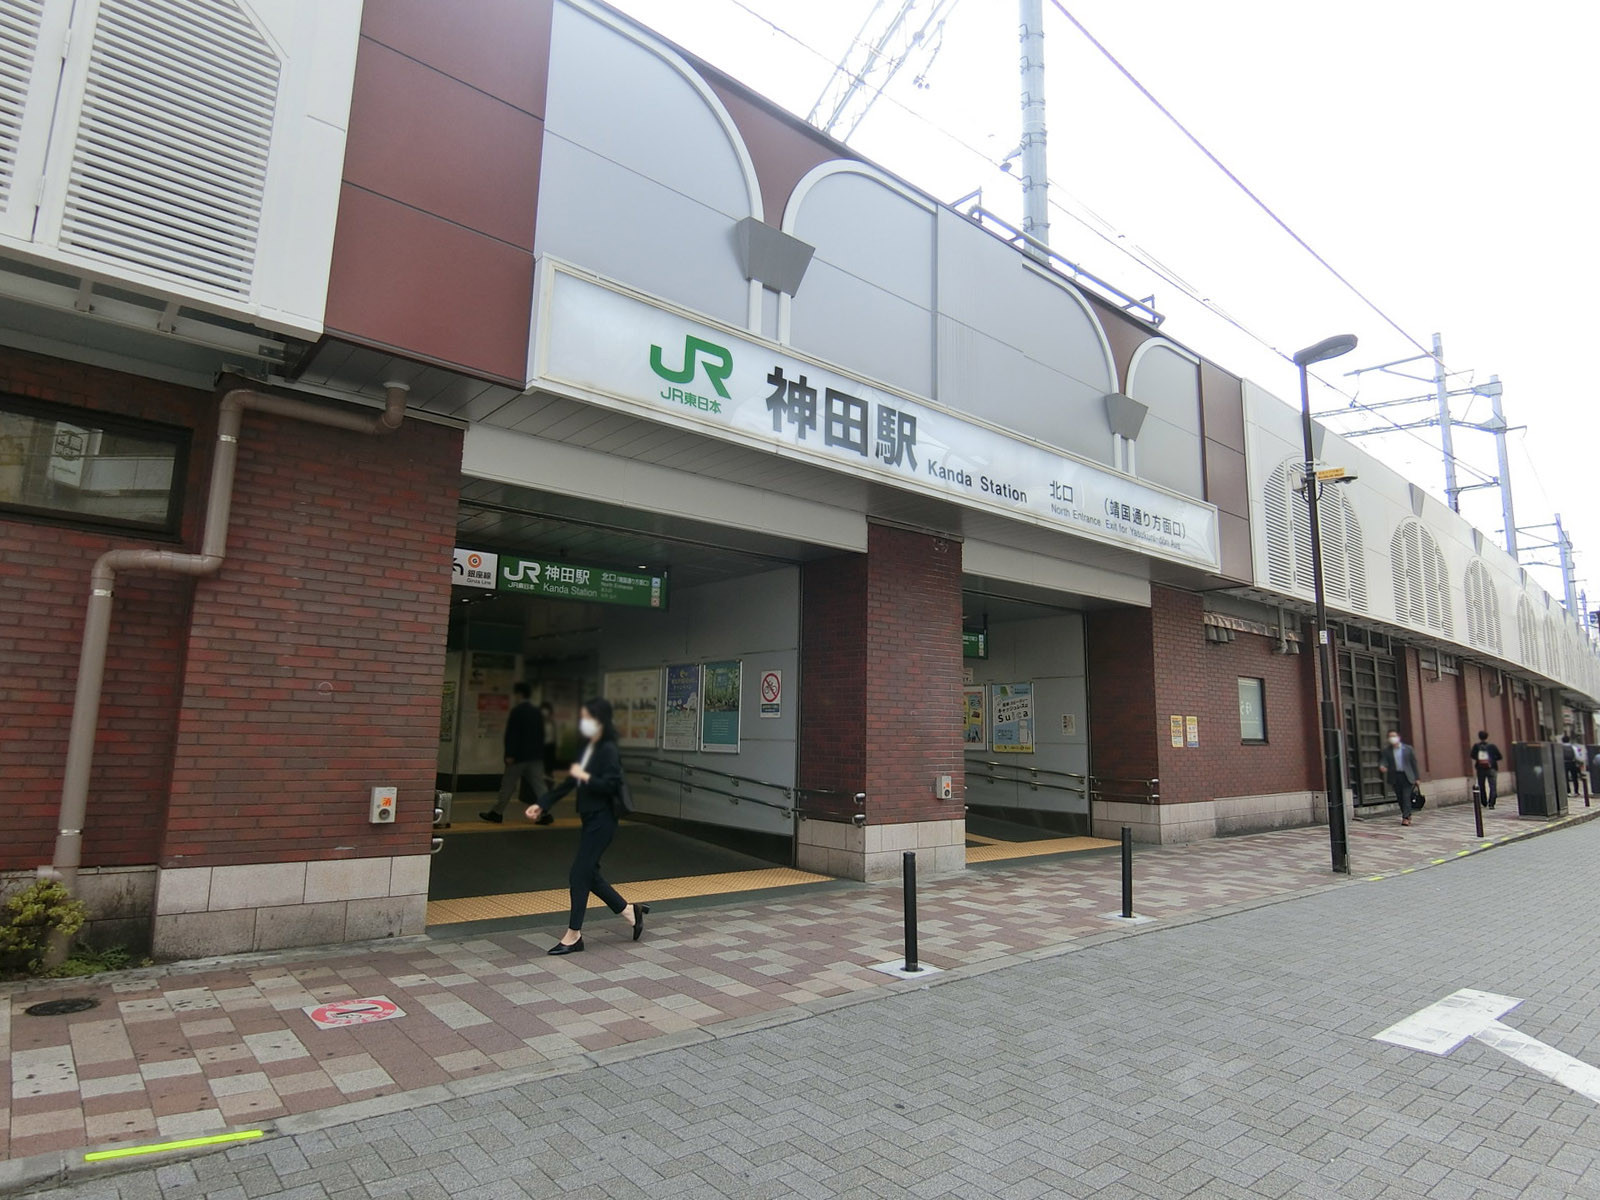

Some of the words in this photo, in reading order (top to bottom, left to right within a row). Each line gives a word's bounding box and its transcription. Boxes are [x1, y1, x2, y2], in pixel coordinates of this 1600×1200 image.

[650, 334, 734, 400] JR
[660, 385, 722, 415] JR東日本
[765, 365, 919, 472] 神田駅
[927, 458, 973, 488] Kanda
[980, 475, 1028, 504] Station
[1050, 480, 1074, 504] 北口
[1051, 503, 1071, 518] North
[1105, 519, 1119, 532] Exit
[1118, 523, 1128, 535] for
[503, 560, 542, 584] JR
[544, 564, 591, 586] 神田駅
[543, 582, 569, 595] Kanda
[570, 586, 598, 599] Station
[997, 710, 1029, 723] Suica
